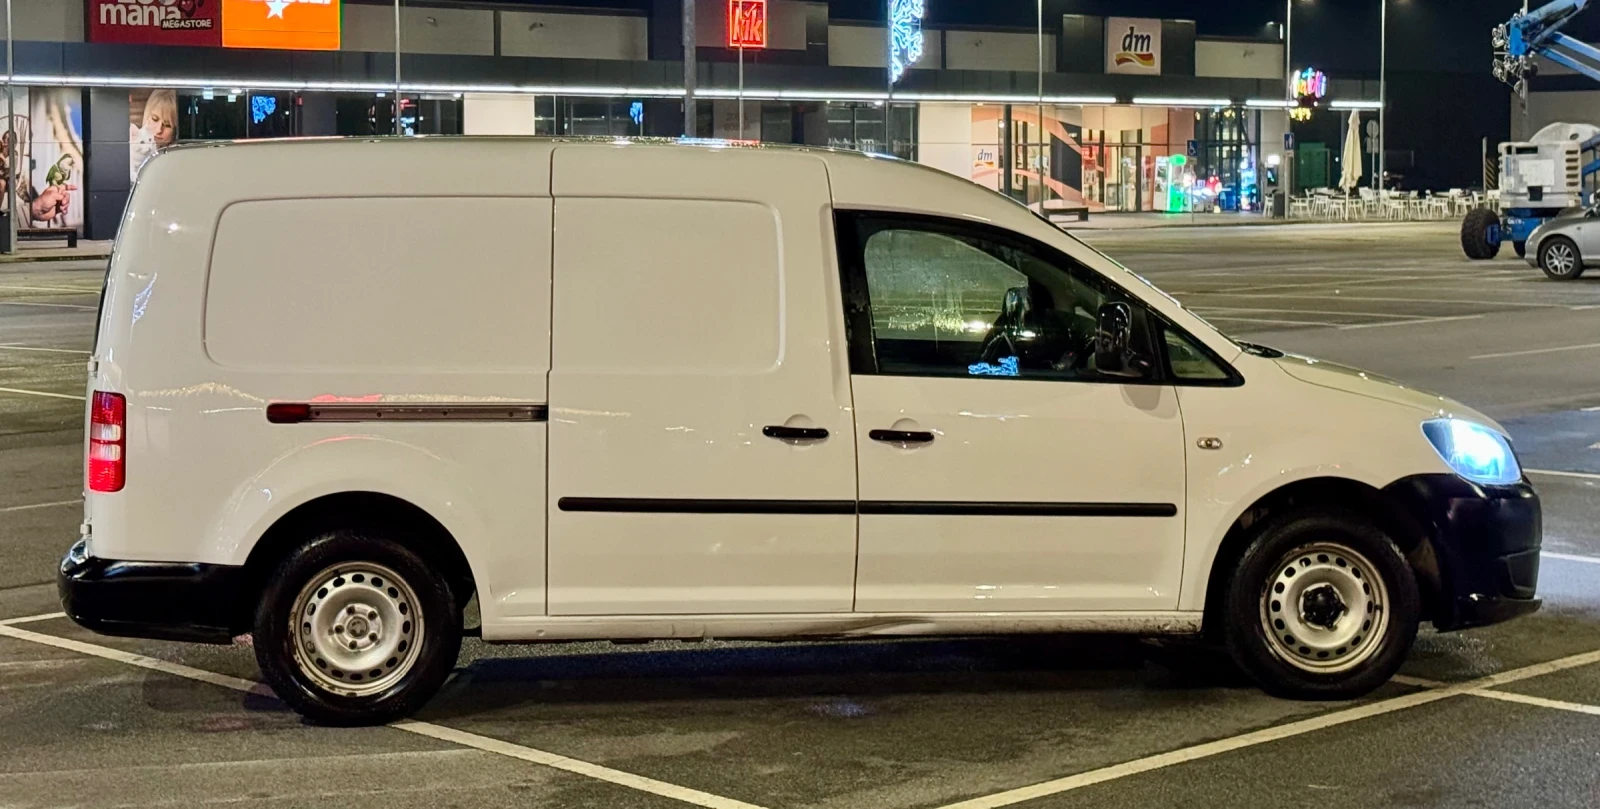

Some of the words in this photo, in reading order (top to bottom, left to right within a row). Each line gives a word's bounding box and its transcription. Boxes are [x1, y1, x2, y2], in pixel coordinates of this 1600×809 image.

[100, 4, 181, 26] mania
[162, 19, 212, 29] MEGASTORE
[1122, 26, 1151, 52] dm
[978, 149, 992, 161] dm
